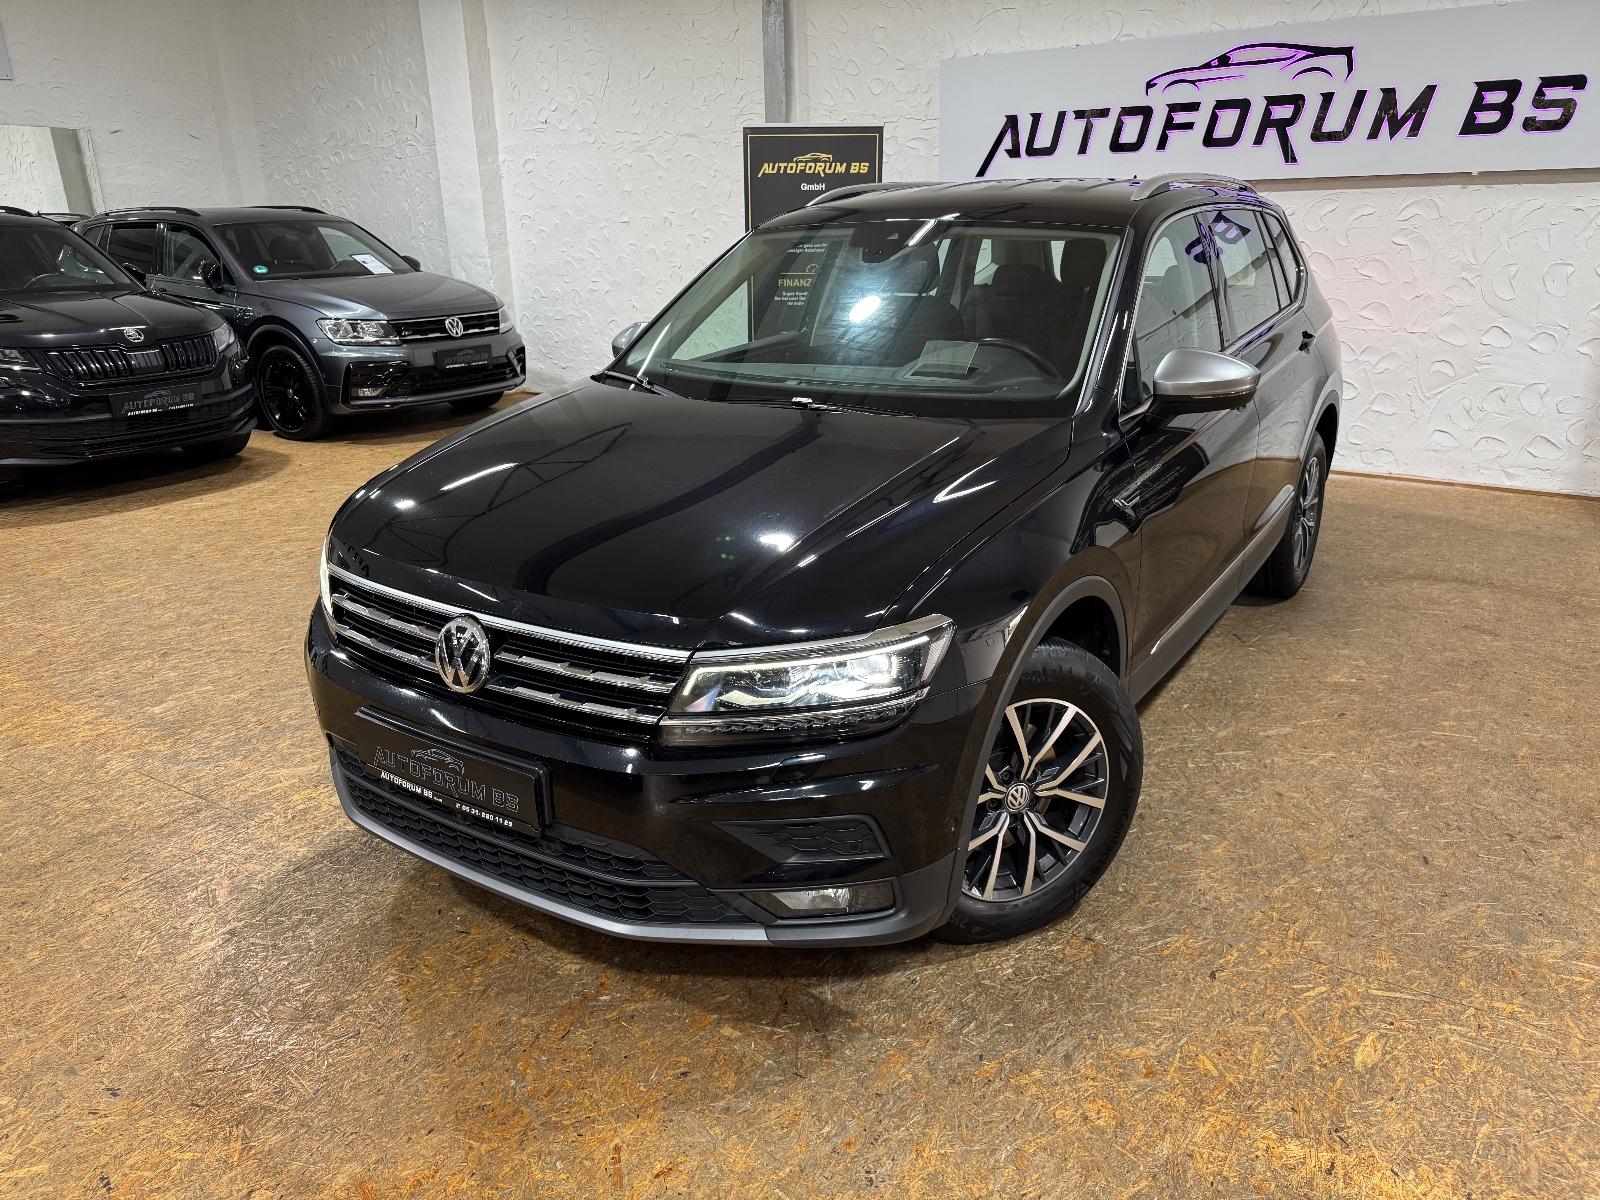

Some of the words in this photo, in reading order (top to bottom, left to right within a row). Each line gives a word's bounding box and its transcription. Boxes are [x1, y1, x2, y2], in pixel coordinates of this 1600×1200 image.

[975, 84, 1439, 178] AUTOFORUM
[1456, 73, 1588, 138] BS
[757, 162, 847, 178] AUTOFORUM
[849, 162, 870, 174] BS
[800, 183, 826, 191] GmbH
[778, 278, 812, 287] FINANZ
[373, 745, 486, 801] AUTOFORUM
[491, 787, 519, 813] BS
[380, 770, 422, 794] AUTOFORUM
